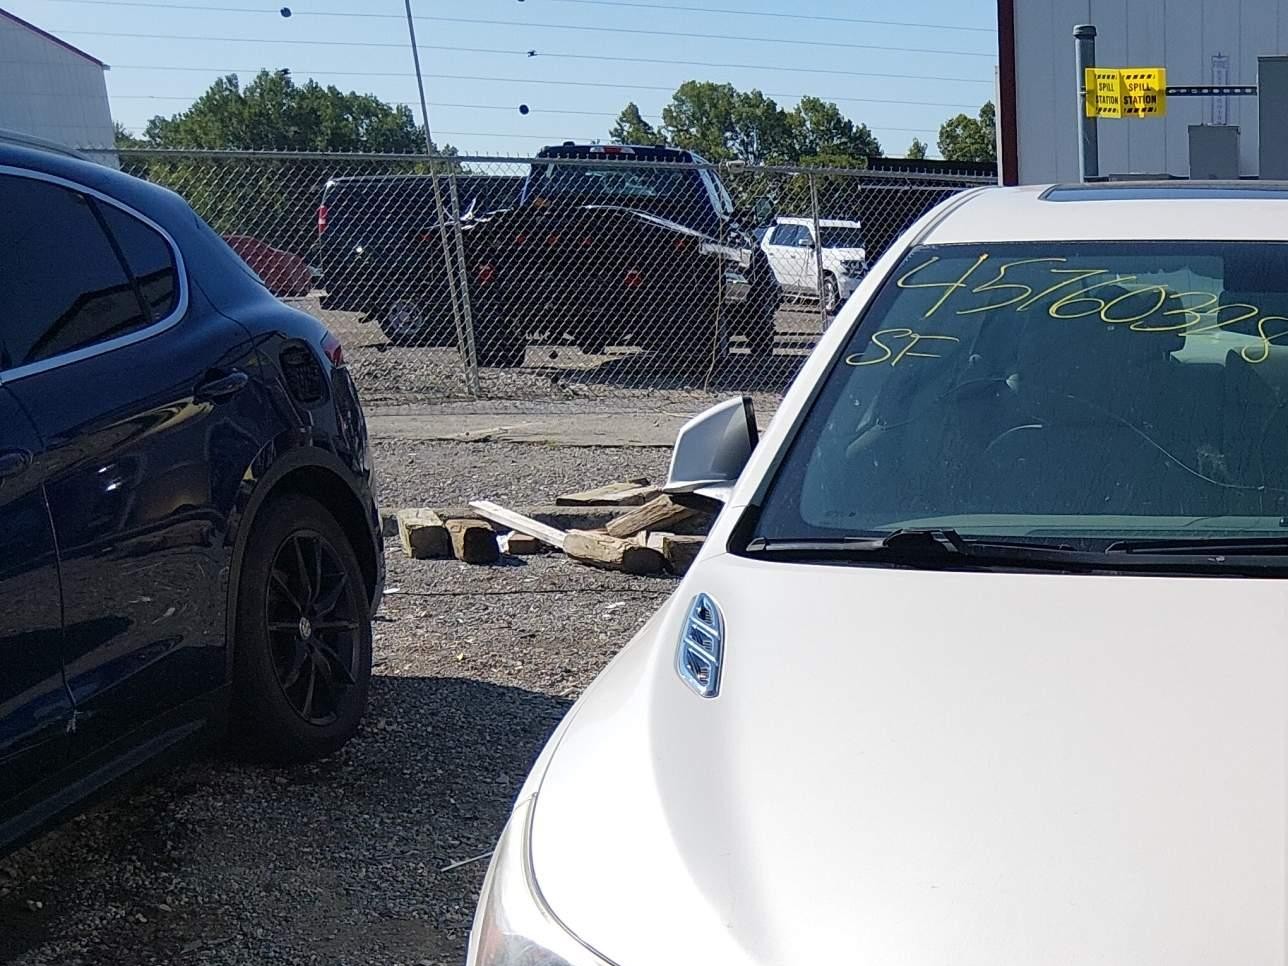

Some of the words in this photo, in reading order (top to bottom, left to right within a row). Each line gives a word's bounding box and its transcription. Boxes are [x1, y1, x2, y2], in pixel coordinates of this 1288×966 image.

[1099, 82, 1115, 92] SPILL
[1128, 82, 1152, 92] SPILL
[1096, 95, 1119, 105] STATION
[1123, 95, 1157, 105] STATION
[845, 328, 959, 367] SF
